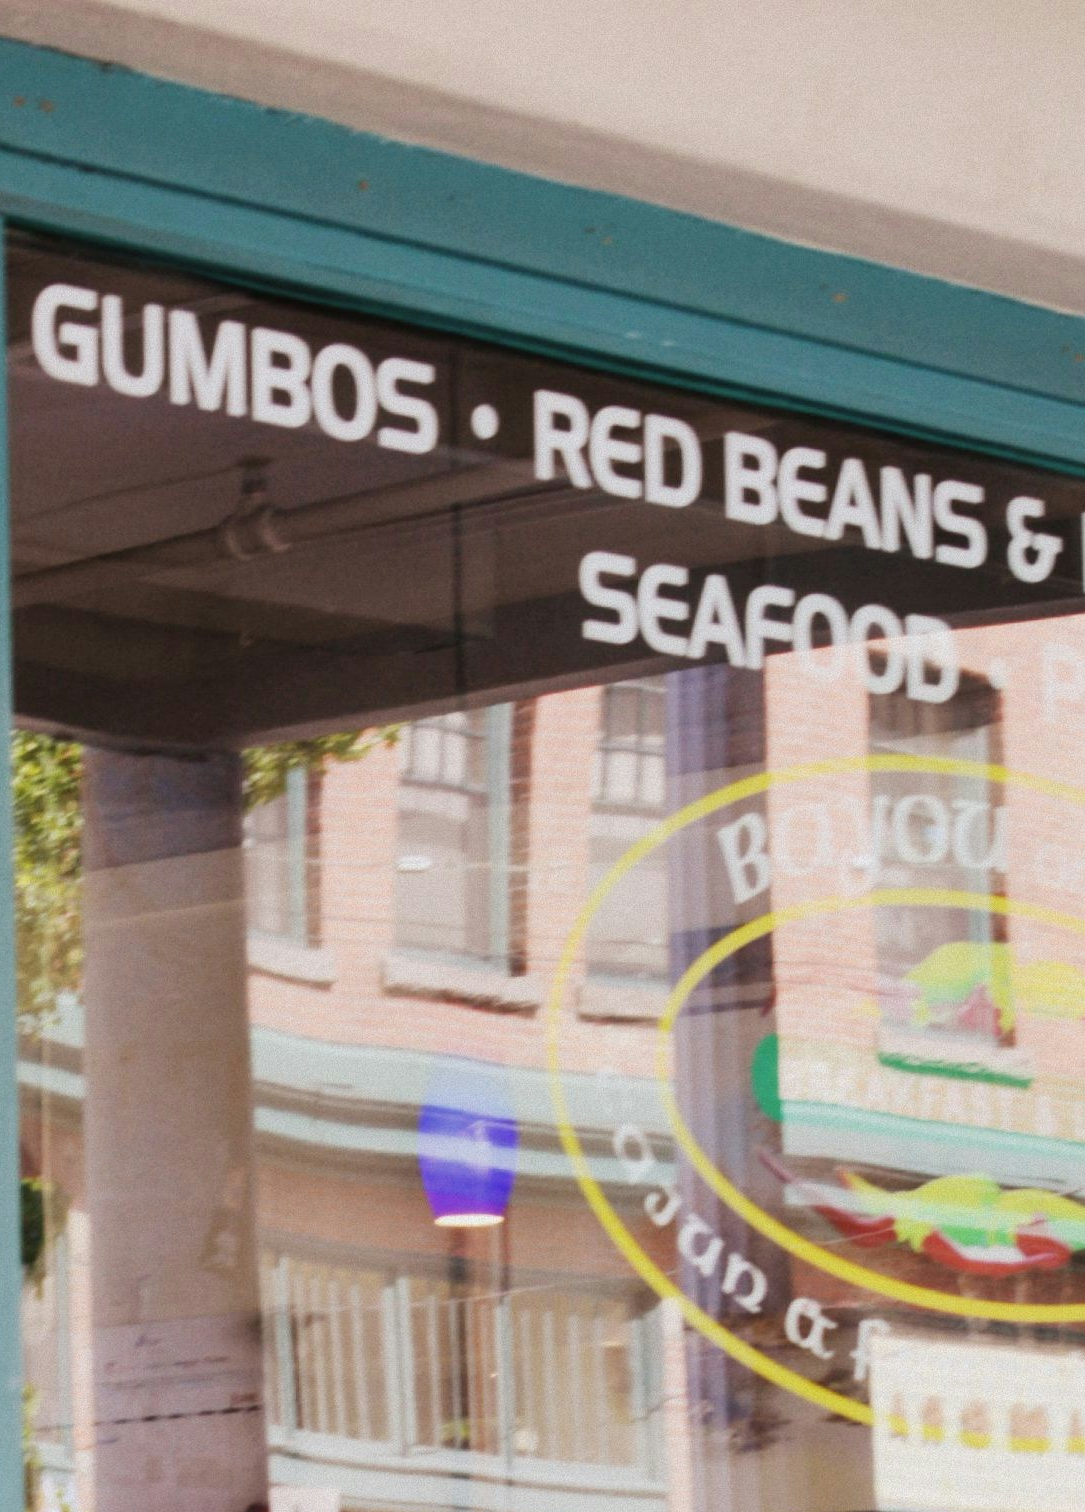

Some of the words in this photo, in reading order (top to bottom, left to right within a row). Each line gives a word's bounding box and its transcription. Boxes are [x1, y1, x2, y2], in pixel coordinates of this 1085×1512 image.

[32, 283, 438, 454] GUMBOS
[534, 389, 702, 508] RED
[724, 431, 989, 570] BEANS
[1005, 495, 1064, 584] &
[579, 552, 960, 706] SEAFOOD
